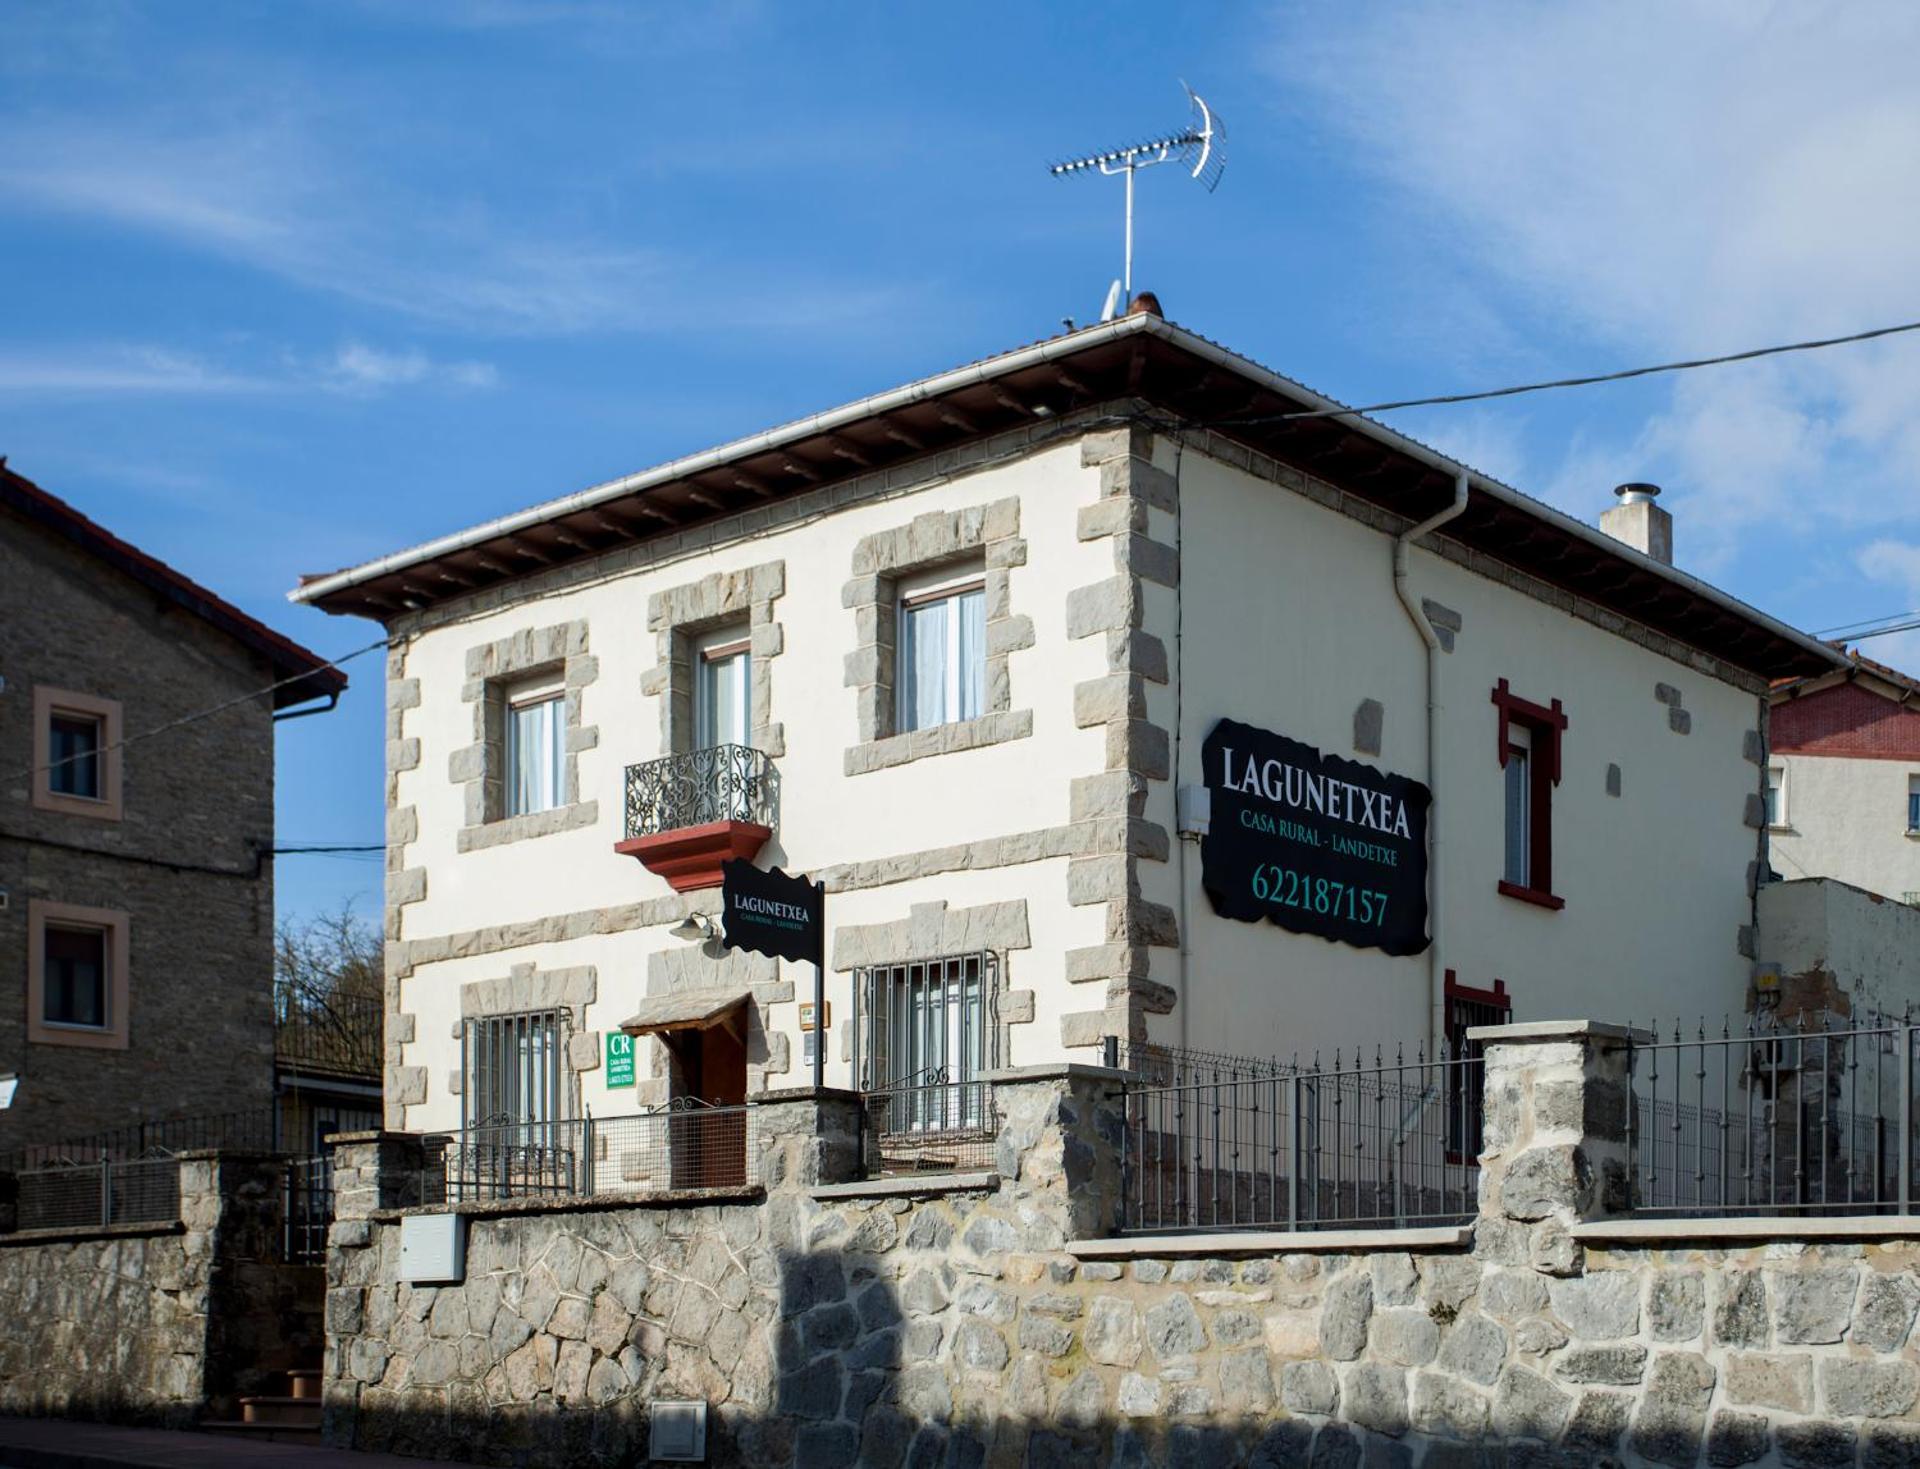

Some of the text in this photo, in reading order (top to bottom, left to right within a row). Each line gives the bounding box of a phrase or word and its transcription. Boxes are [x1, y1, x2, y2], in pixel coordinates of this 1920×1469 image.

[1222, 747, 1412, 840] LAGUNETXEA
[1240, 809, 1276, 835] CASA
[1279, 819, 1321, 848] RURAL
[1332, 835, 1398, 867] LANDETXE
[734, 893, 809, 922] LAGUNETXEA
[1252, 863, 1388, 927] 622187157
[611, 1034, 631, 1055] CR
